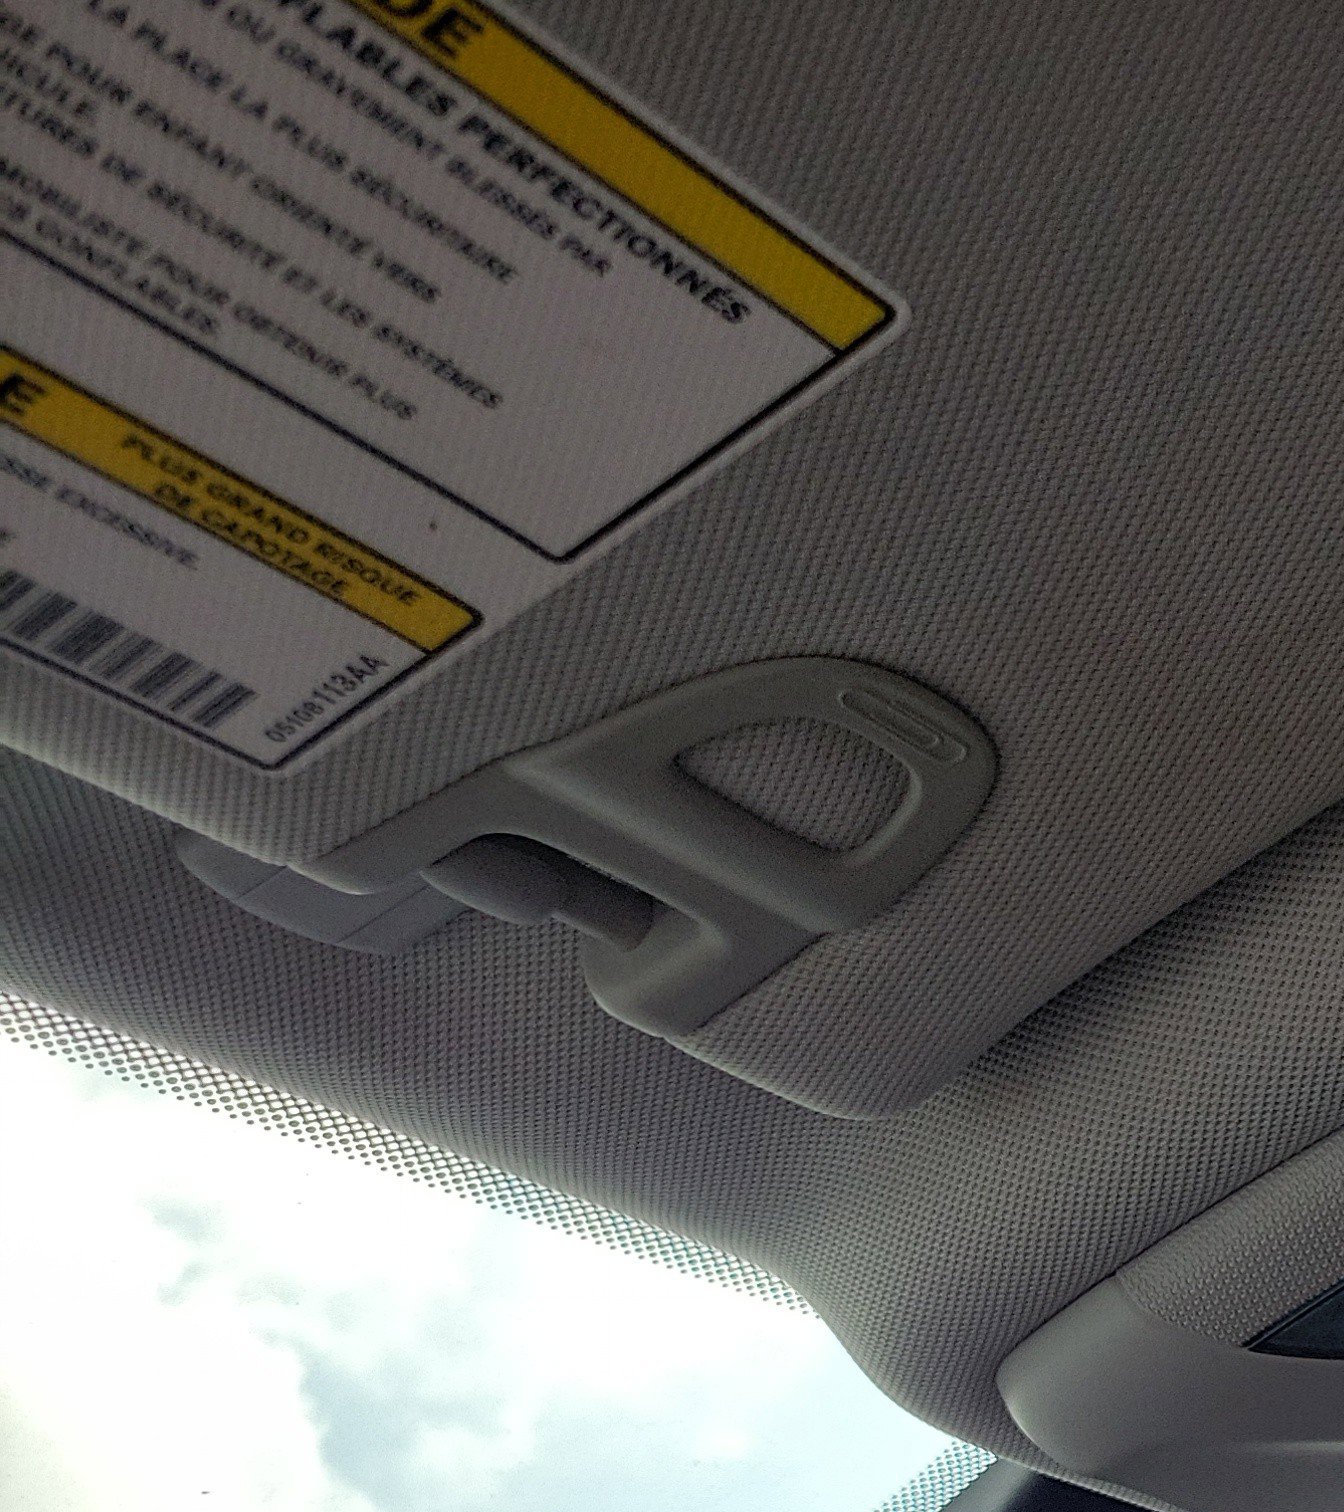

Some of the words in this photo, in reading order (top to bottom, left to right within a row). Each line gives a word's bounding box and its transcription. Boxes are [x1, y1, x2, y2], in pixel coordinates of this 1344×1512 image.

[46, 43, 134, 105] POUR
[133, 100, 251, 179] ENFANT
[250, 176, 371, 261] ORIENTÉ
[372, 250, 441, 304] VERS
[131, 20, 226, 94] PLACE
[229, 84, 269, 122] LA
[271, 114, 348, 173] PLUS
[350, 163, 517, 285] SÉCURITAIRE
[226, 5, 274, 46] OU
[275, 40, 444, 160] GRAVEMENT
[446, 153, 557, 241] BLESSÉS
[559, 235, 611, 277] PAR
[277, 0, 457, 117] LABLES
[458, 113, 751, 324] PERFECTIONNÉS
[101, 154, 146, 185] DE
[147, 178, 284, 272] SÉCURITÉ
[280, 265, 319, 295] ET
[320, 287, 371, 329] LES
[373, 322, 504, 409] SYSTÈMES
[148, 254, 230, 306] POUR
[231, 302, 348, 379] OBTENIR
[350, 374, 417, 420] PLUS
[55, 484, 199, 571] EXCESSIVE
[119, 434, 201, 486] PLUS
[205, 481, 309, 545] GRAND
[315, 542, 421, 607] RISQUE
[154, 480, 194, 514] DE
[201, 507, 348, 598] CAPOTAGE
